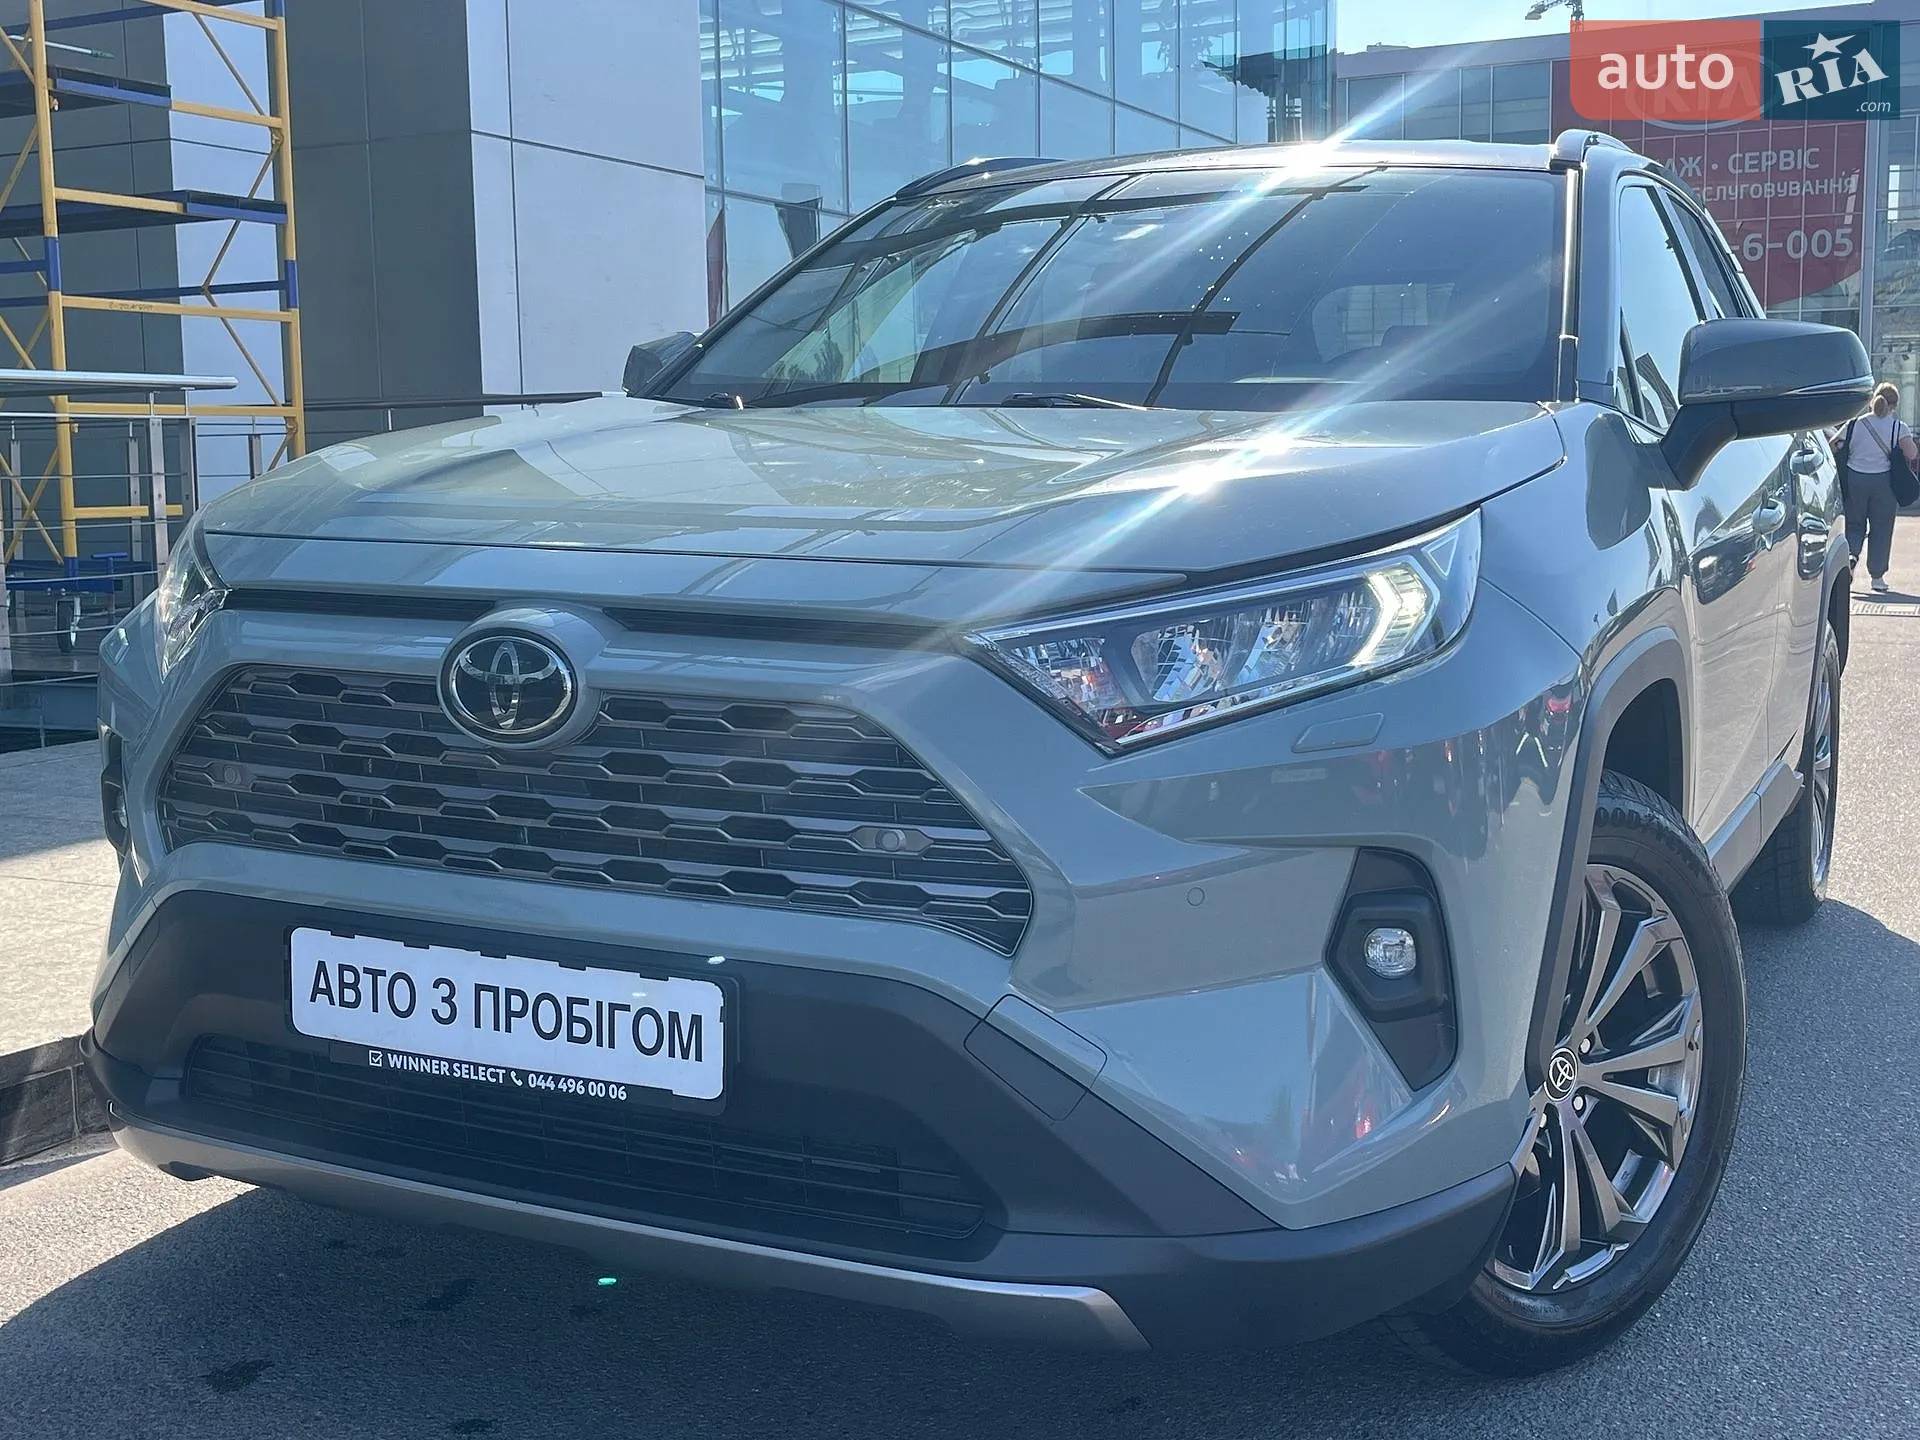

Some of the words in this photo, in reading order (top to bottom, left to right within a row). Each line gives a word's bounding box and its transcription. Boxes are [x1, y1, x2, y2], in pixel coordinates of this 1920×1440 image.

[1727, 147, 1820, 175] СЕРВІС
[309, 960, 417, 1019] АВТО
[431, 977, 458, 1025] З
[474, 982, 704, 1063] ПРОБІГОМ
[387, 1053, 451, 1076] WINNER
[452, 1063, 506, 1084] SELECT
[528, 1073, 556, 1091] 044
[557, 1078, 585, 1096] 496
[588, 1081, 606, 1098] 00
[608, 1084, 627, 1101] 06
